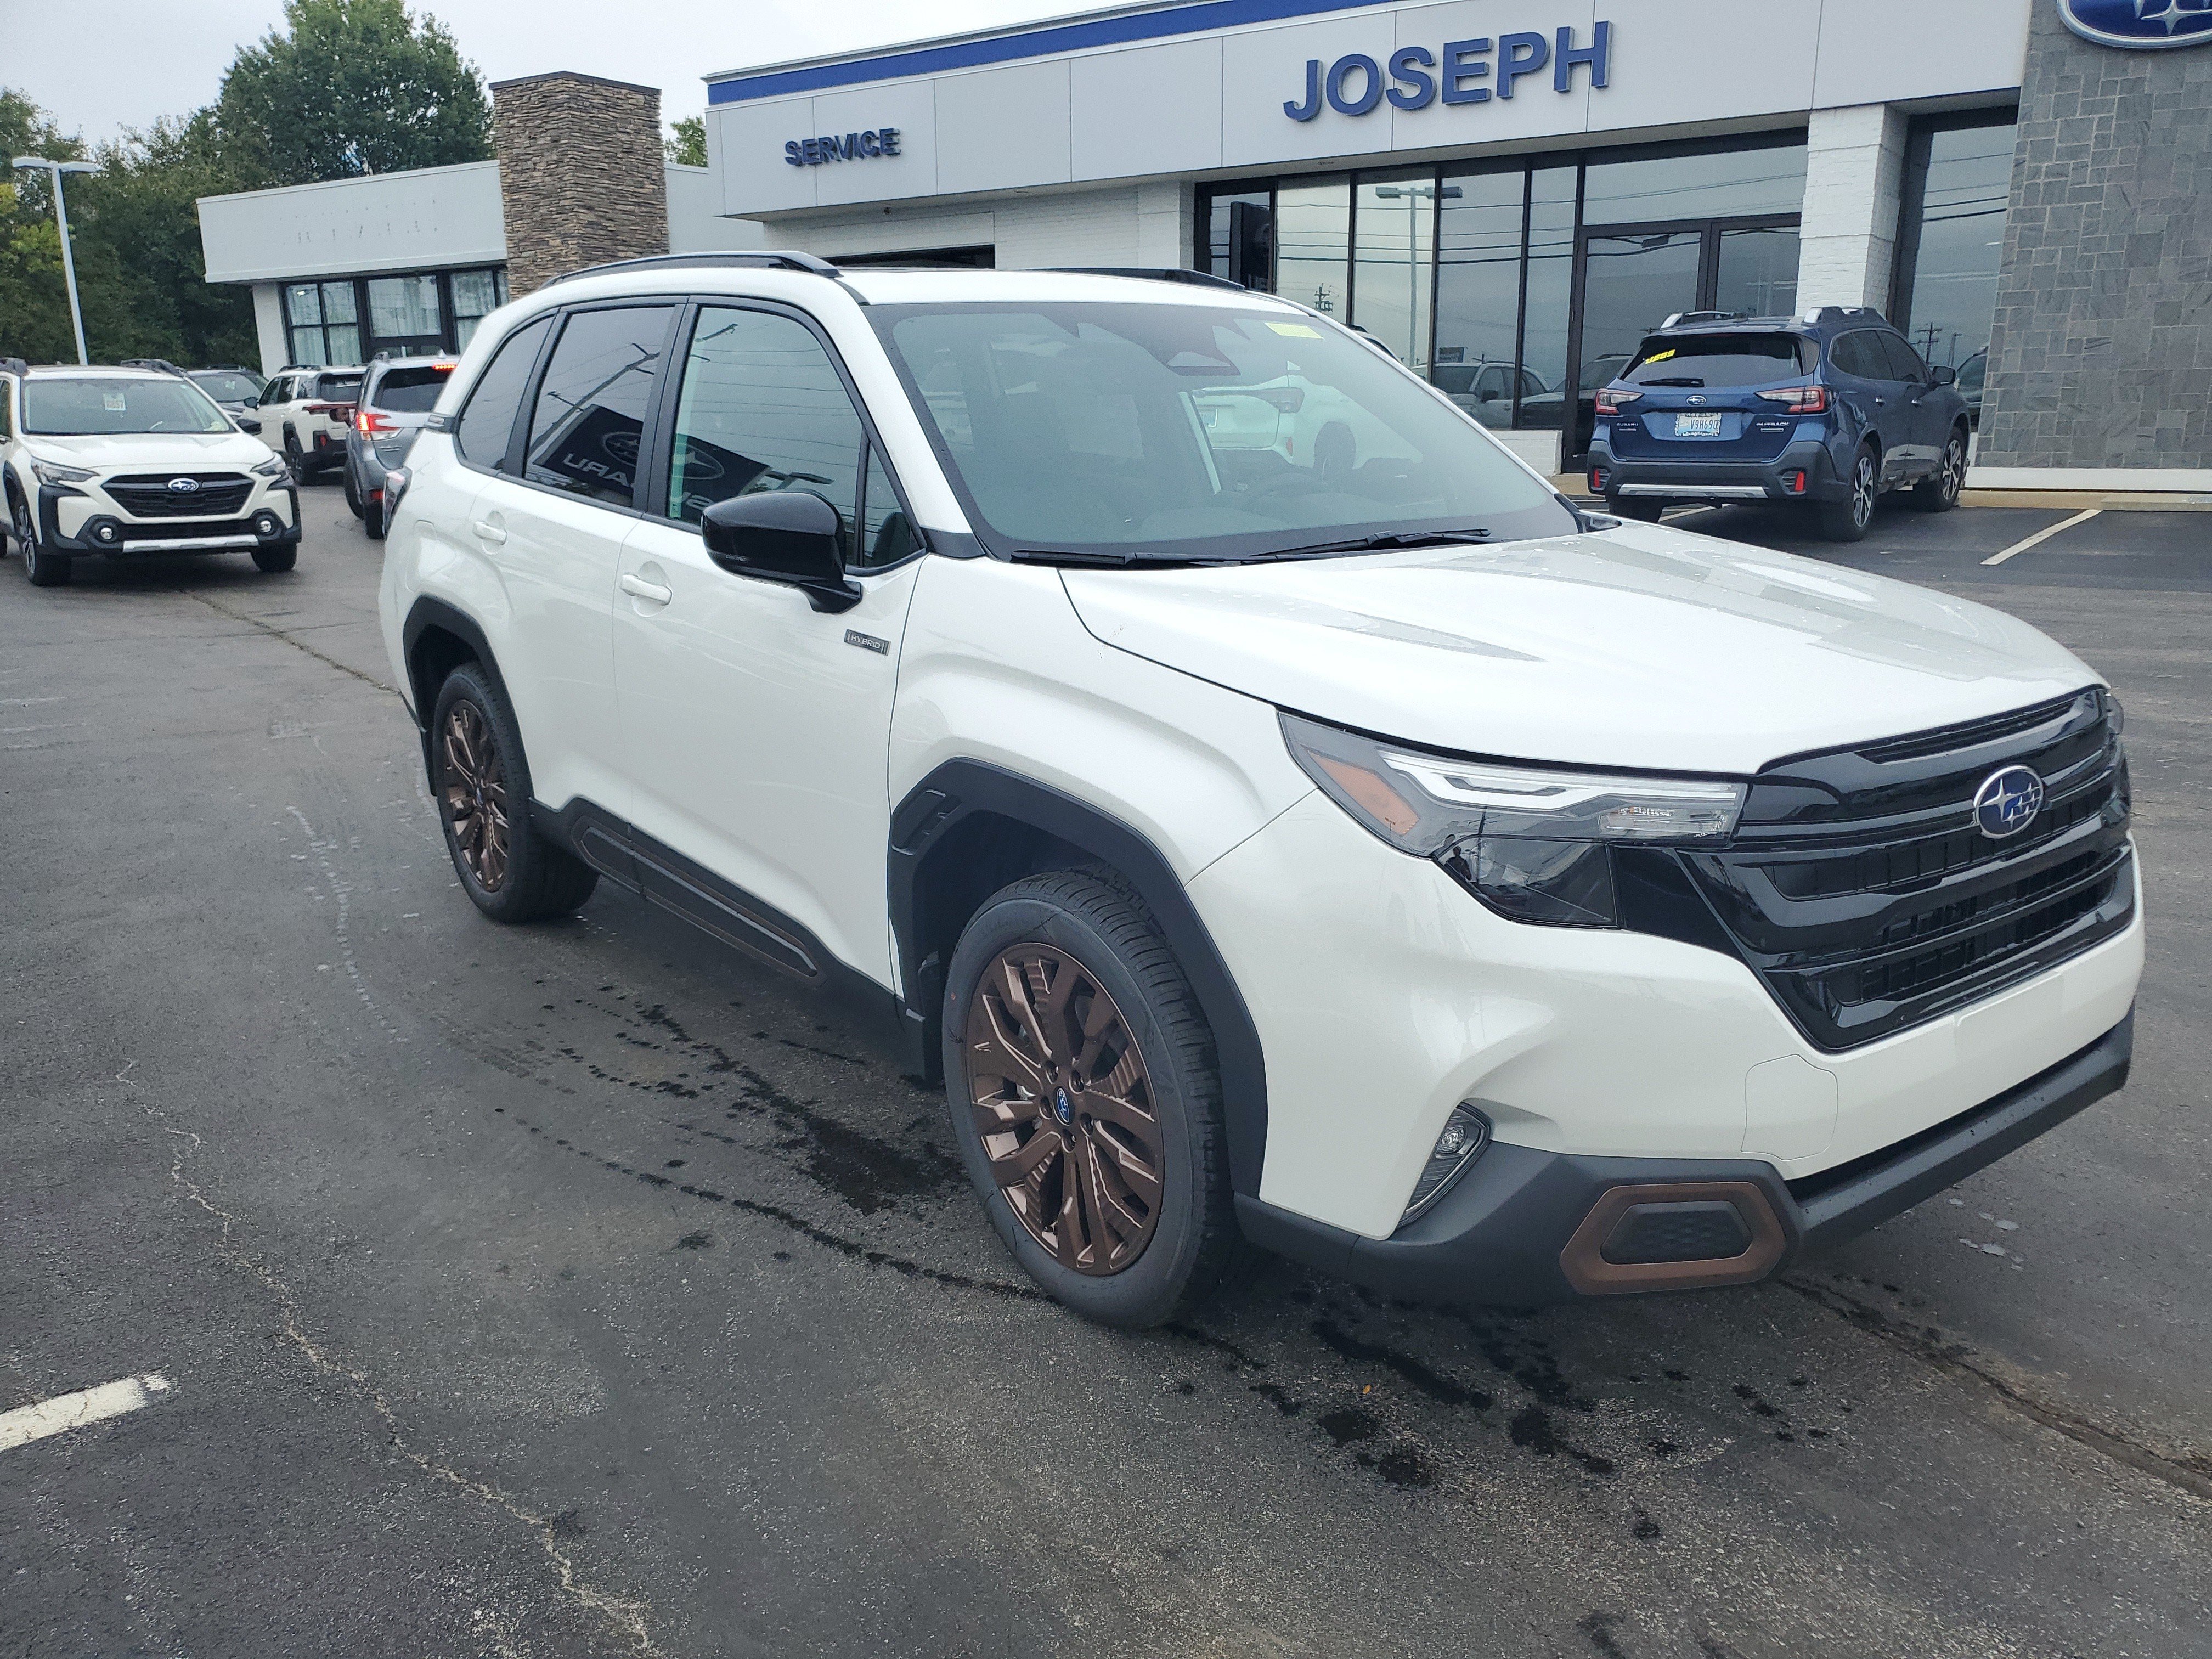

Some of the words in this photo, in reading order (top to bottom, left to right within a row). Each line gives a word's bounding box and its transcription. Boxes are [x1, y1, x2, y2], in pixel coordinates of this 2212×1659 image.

[1283, 20, 1613, 122] JOSEPH
[785, 128, 901, 166] SERVICE
[1645, 349, 1675, 365] JEGS
[1691, 419, 1718, 430] V9H690
[851, 635, 881, 648] HYBRID
